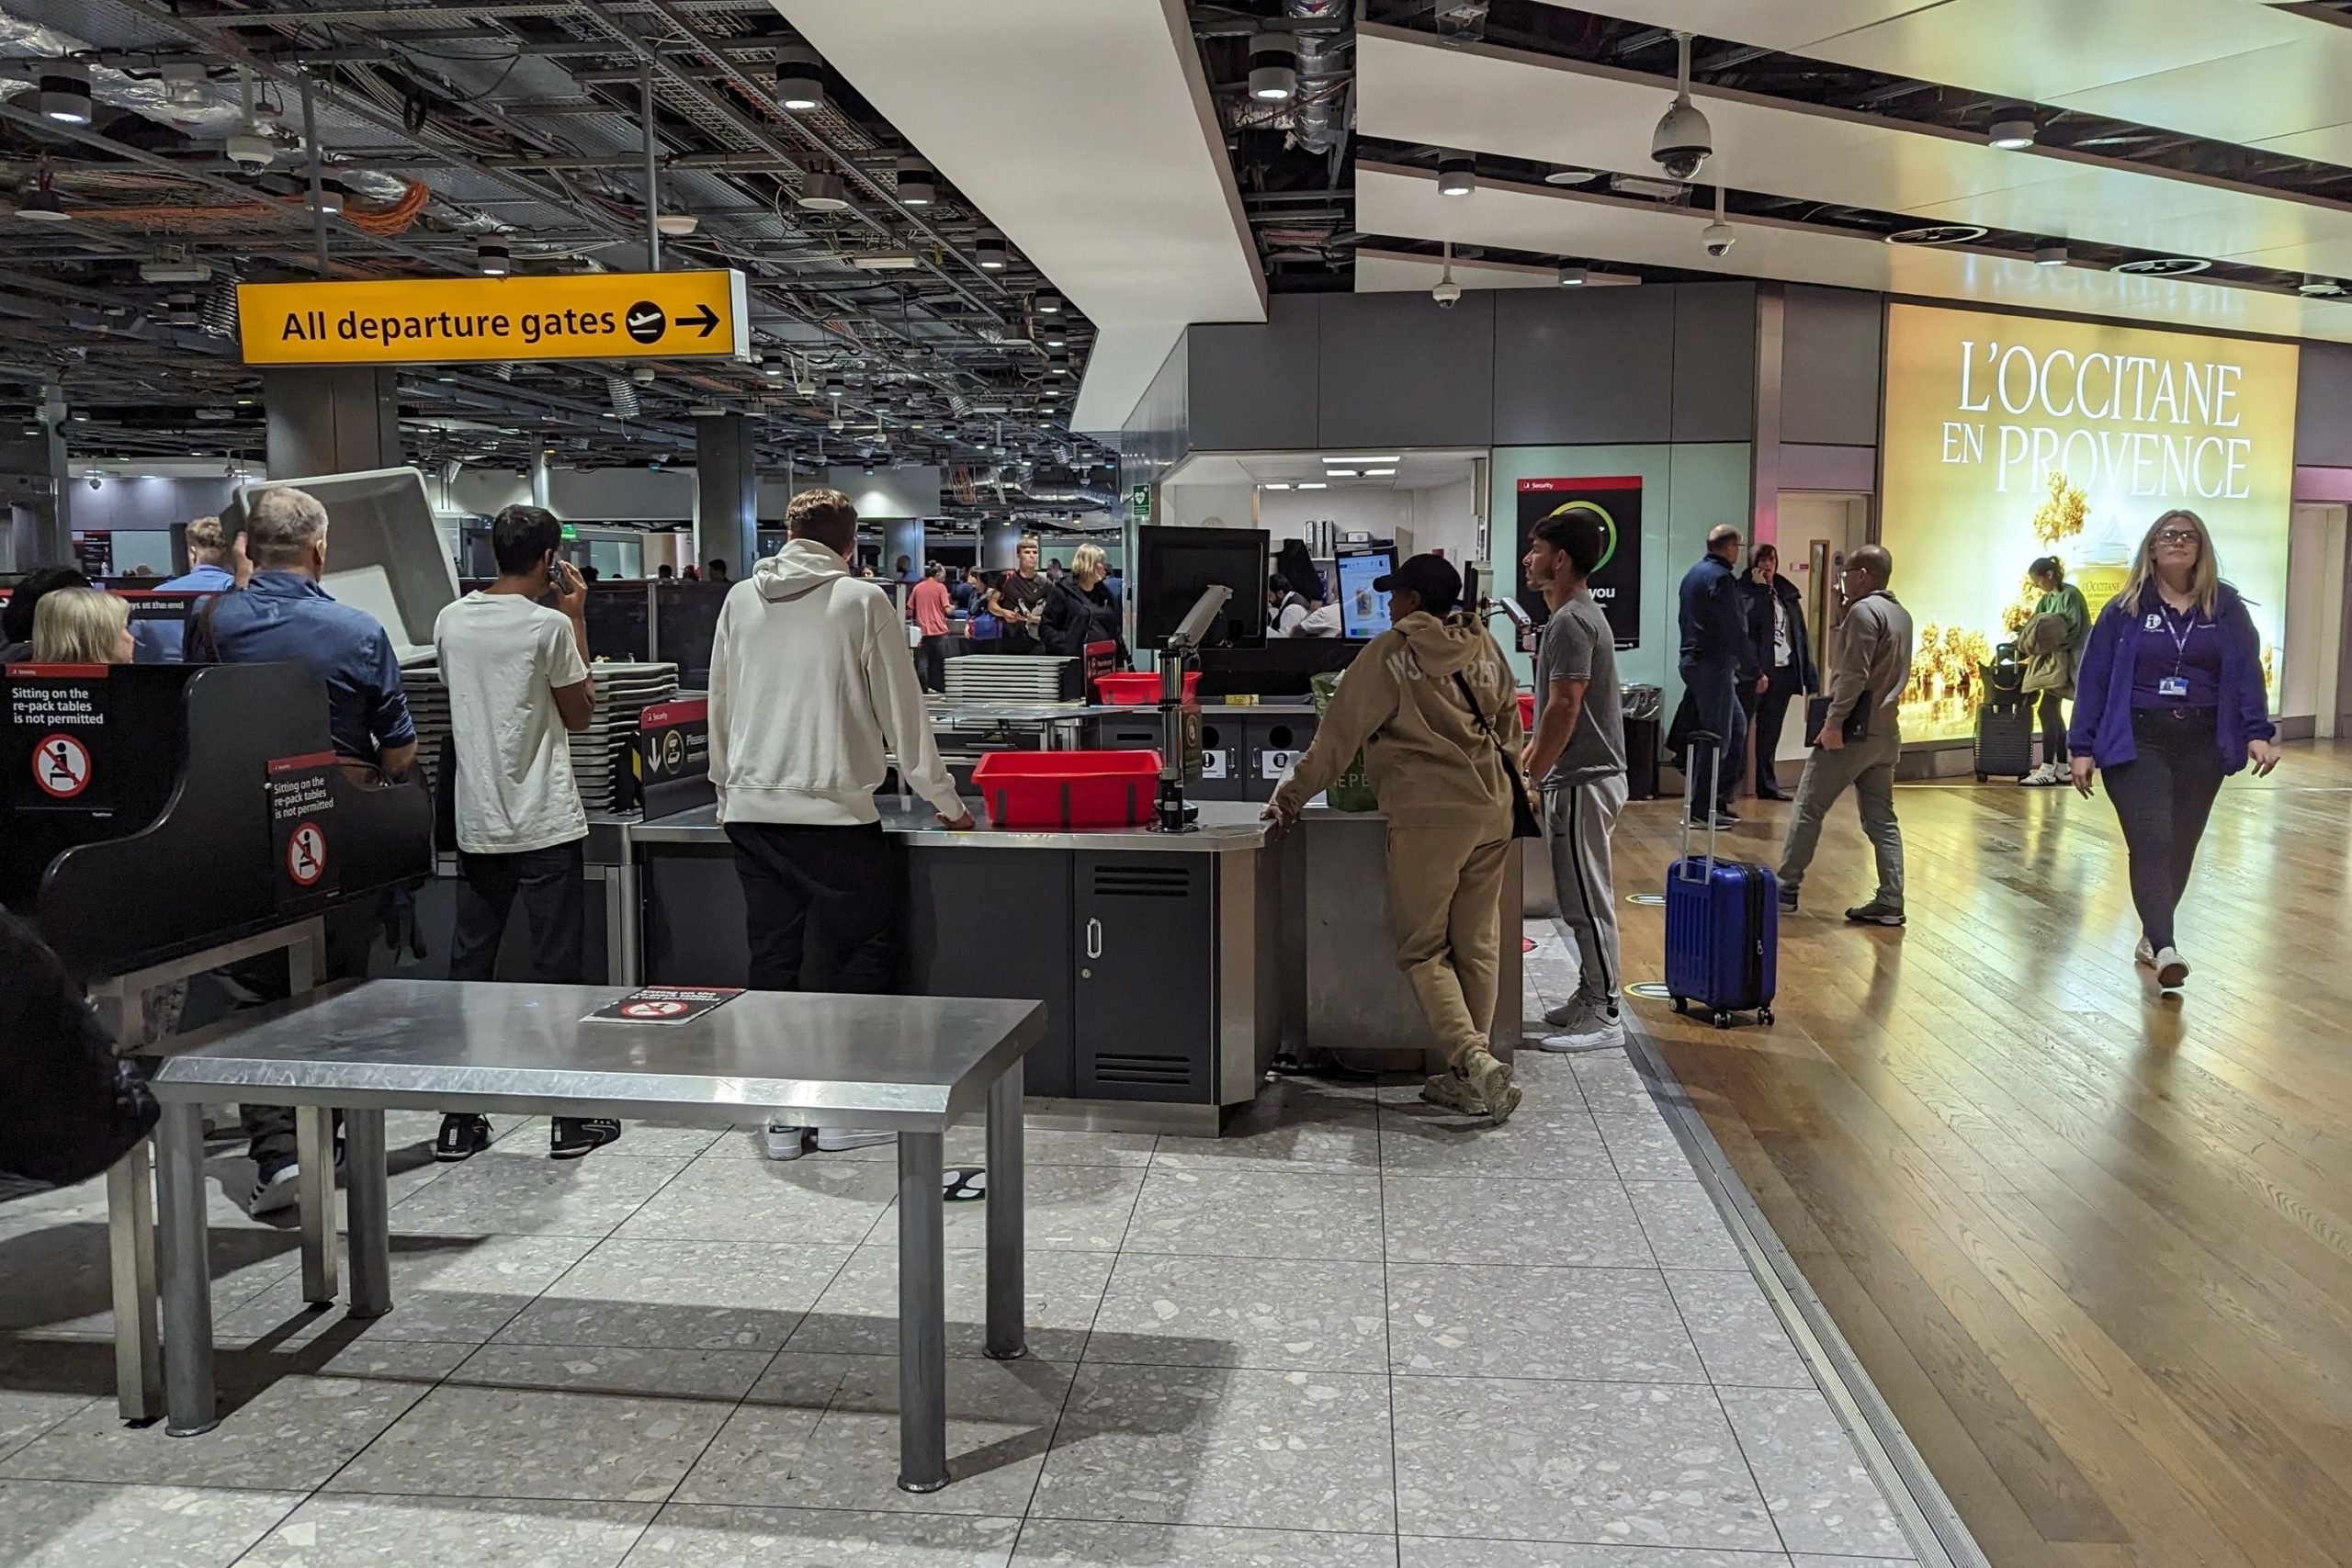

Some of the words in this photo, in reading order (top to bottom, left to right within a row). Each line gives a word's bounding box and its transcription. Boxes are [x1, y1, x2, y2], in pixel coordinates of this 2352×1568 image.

[281, 310, 326, 342] All
[337, 310, 511, 347] departure
[520, 307, 616, 346] gates
[1958, 340, 2242, 427] L'OCCITANE
[1941, 422, 1985, 464] EN
[1996, 425, 2251, 499] PROVENCE
[1588, 588, 1615, 600] you
[12, 687, 50, 701] Sitting
[51, 690, 67, 699] on
[69, 688, 89, 699] the
[13, 701, 55, 713] re-pack
[57, 701, 92, 712] tables
[14, 713, 23, 724] is
[26, 715, 45, 724] not
[48, 714, 104, 726] permitted
[274, 781, 300, 795] Sitting
[300, 781, 311, 789] on
[312, 776, 324, 787] the
[274, 794, 303, 807] re-pack
[304, 788, 327, 801] tables
[275, 809, 282, 819] is
[283, 807, 296, 818] not
[298, 797, 334, 817] permitted
